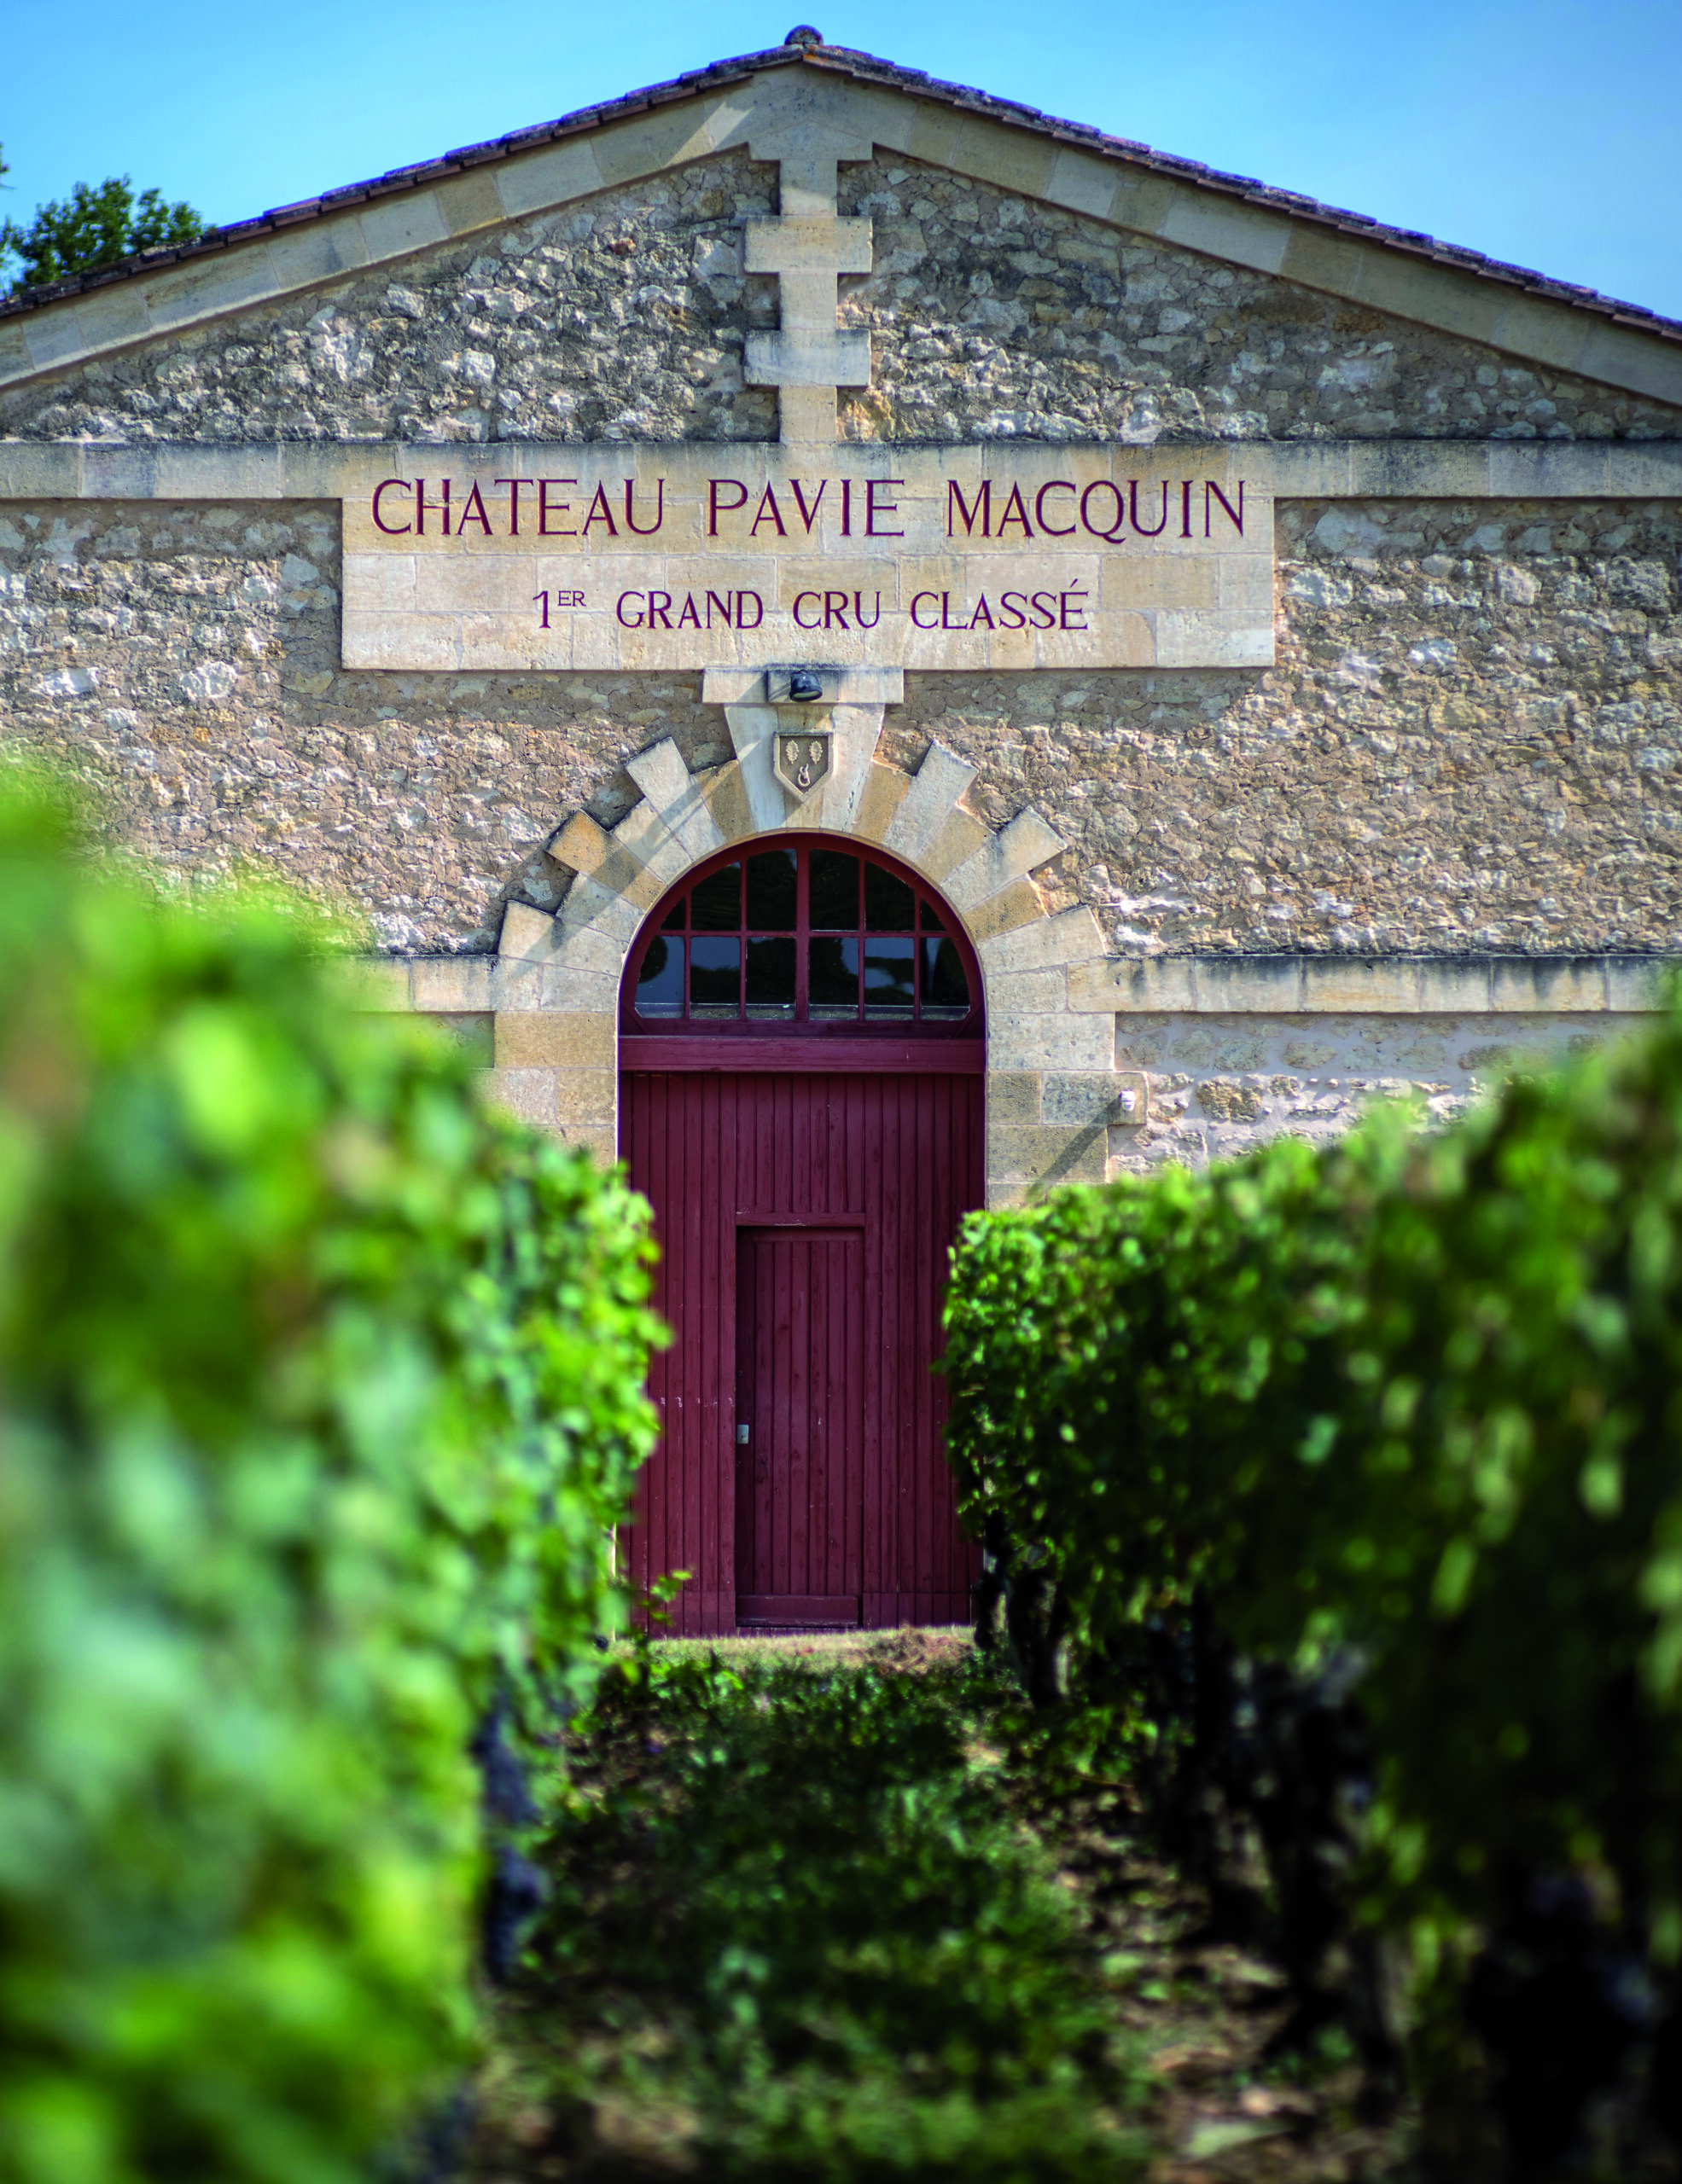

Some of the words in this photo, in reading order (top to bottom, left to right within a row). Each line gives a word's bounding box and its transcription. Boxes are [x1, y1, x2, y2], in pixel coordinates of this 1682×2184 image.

[371, 478, 666, 537] CHATEAU
[707, 479, 905, 537] PAVIE
[946, 479, 1247, 544] MACQUIN
[532, 590, 587, 629] 1ER
[615, 590, 764, 630] GRAND
[792, 590, 882, 630] CRU
[910, 578, 1089, 630] CLASSÉ
